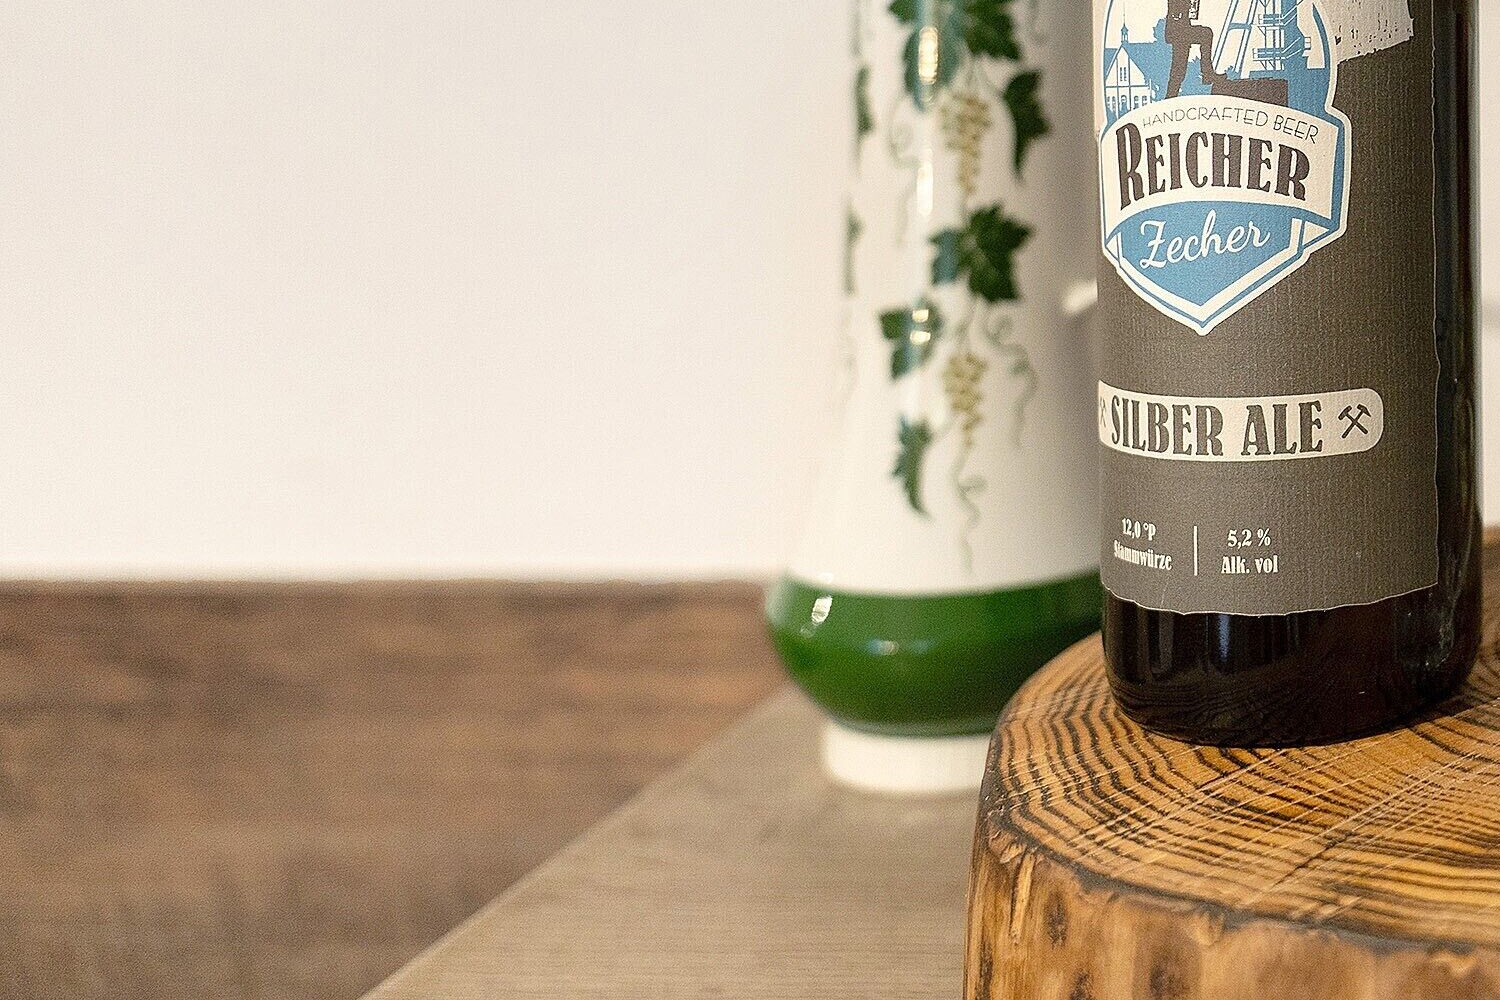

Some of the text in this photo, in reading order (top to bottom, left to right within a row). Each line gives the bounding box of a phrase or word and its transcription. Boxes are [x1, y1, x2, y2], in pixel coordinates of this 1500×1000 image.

[1143, 106, 1320, 144] HANDCRAFTED BEER
[1115, 122, 1311, 211] REICHER
[1140, 209, 1271, 269] Zecher
[1110, 394, 1324, 457] SILBER ALE
[1113, 539, 1173, 571] Stammwürze
[1227, 527, 1272, 550] 5,2 %
[1220, 554, 1279, 575] Alk. vol
